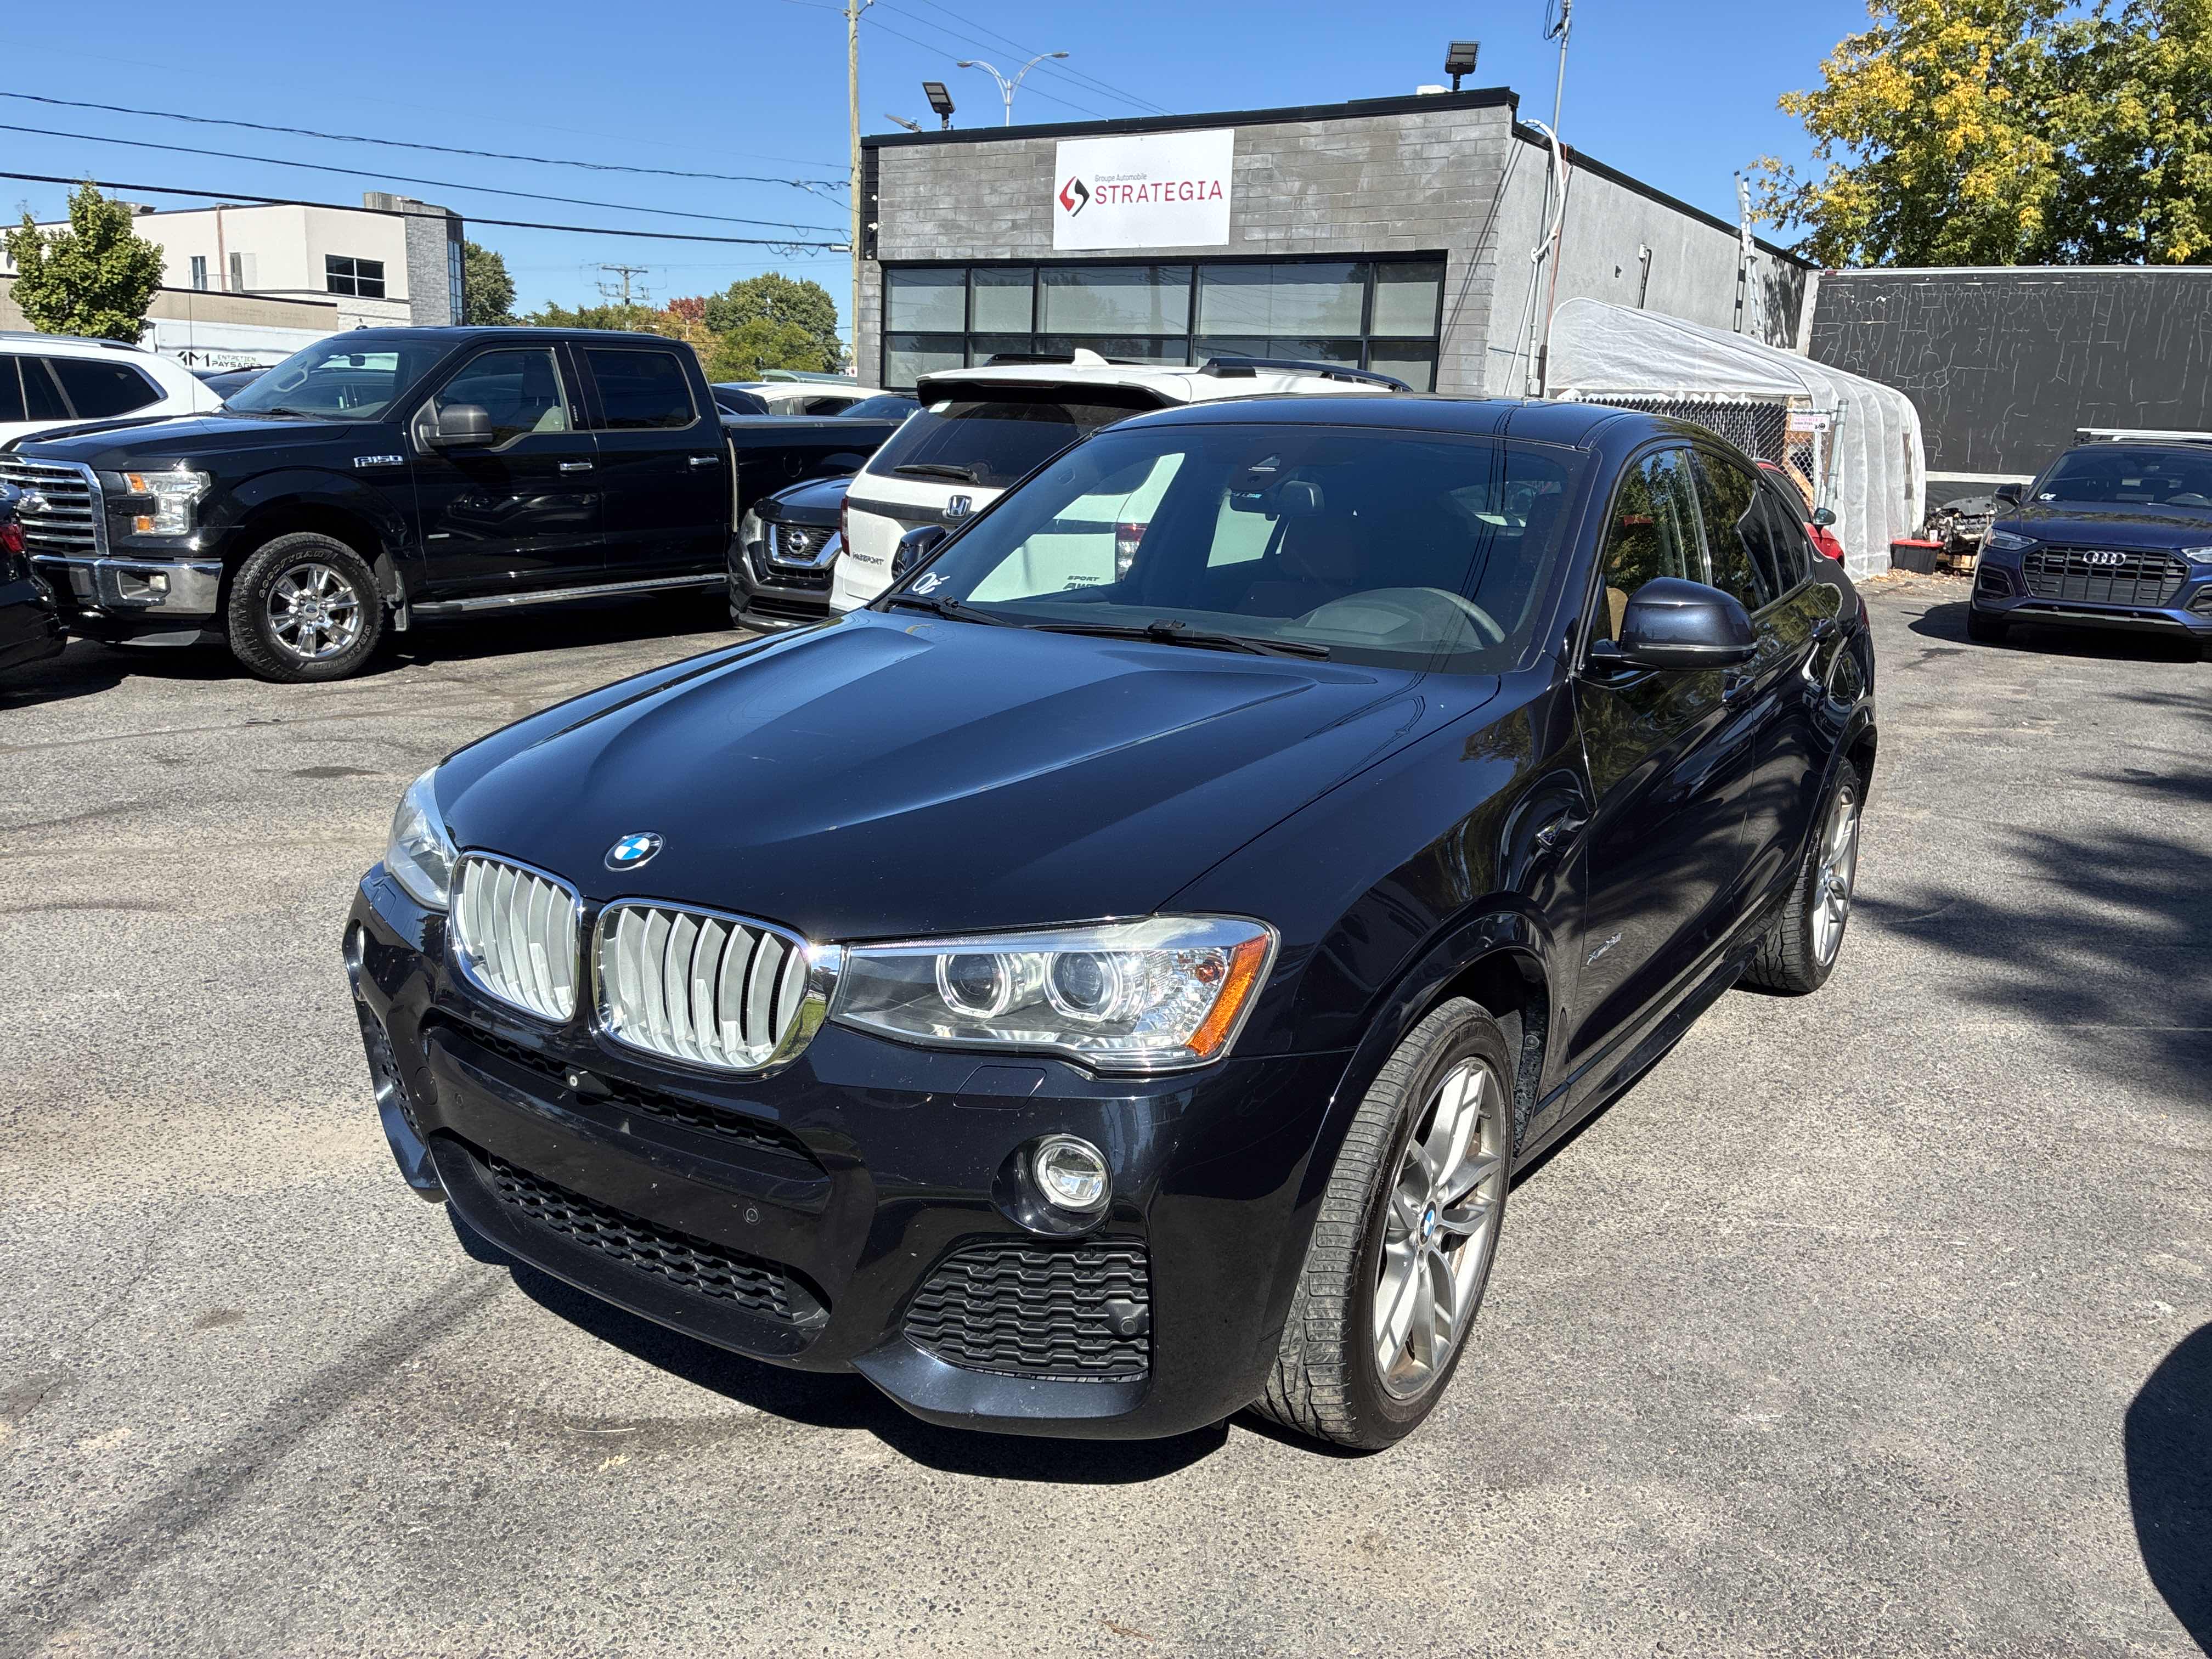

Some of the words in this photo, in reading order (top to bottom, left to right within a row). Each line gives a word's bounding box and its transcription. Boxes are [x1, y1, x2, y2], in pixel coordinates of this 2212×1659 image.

[1095, 174, 1115, 183] Groupe
[1116, 173, 1147, 181] Automobile
[1095, 180, 1223, 205] STRATEGIA
[258, 550, 325, 599] GOODYEAR
